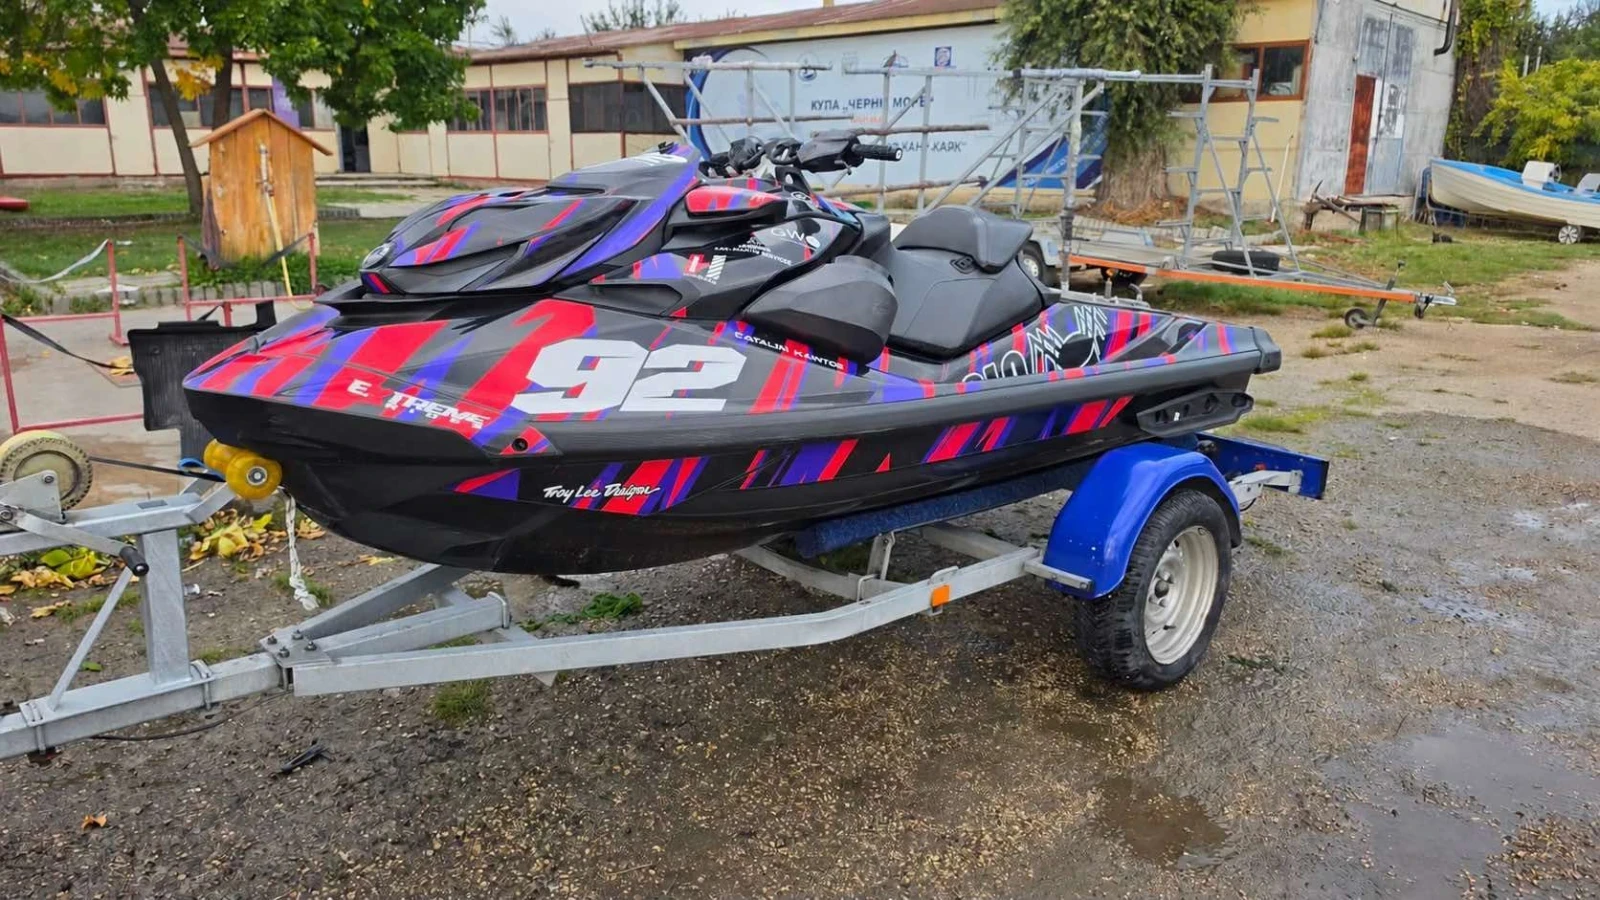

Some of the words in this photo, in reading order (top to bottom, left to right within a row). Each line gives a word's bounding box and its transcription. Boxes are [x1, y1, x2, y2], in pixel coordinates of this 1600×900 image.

[811, 99, 839, 111] КУПА
[842, 98, 884, 111] „ЧЕРН
[734, 331, 789, 353] CATALIN
[510, 338, 747, 415] 92
[543, 485, 575, 504] Troy
[574, 485, 602, 498] Lee
